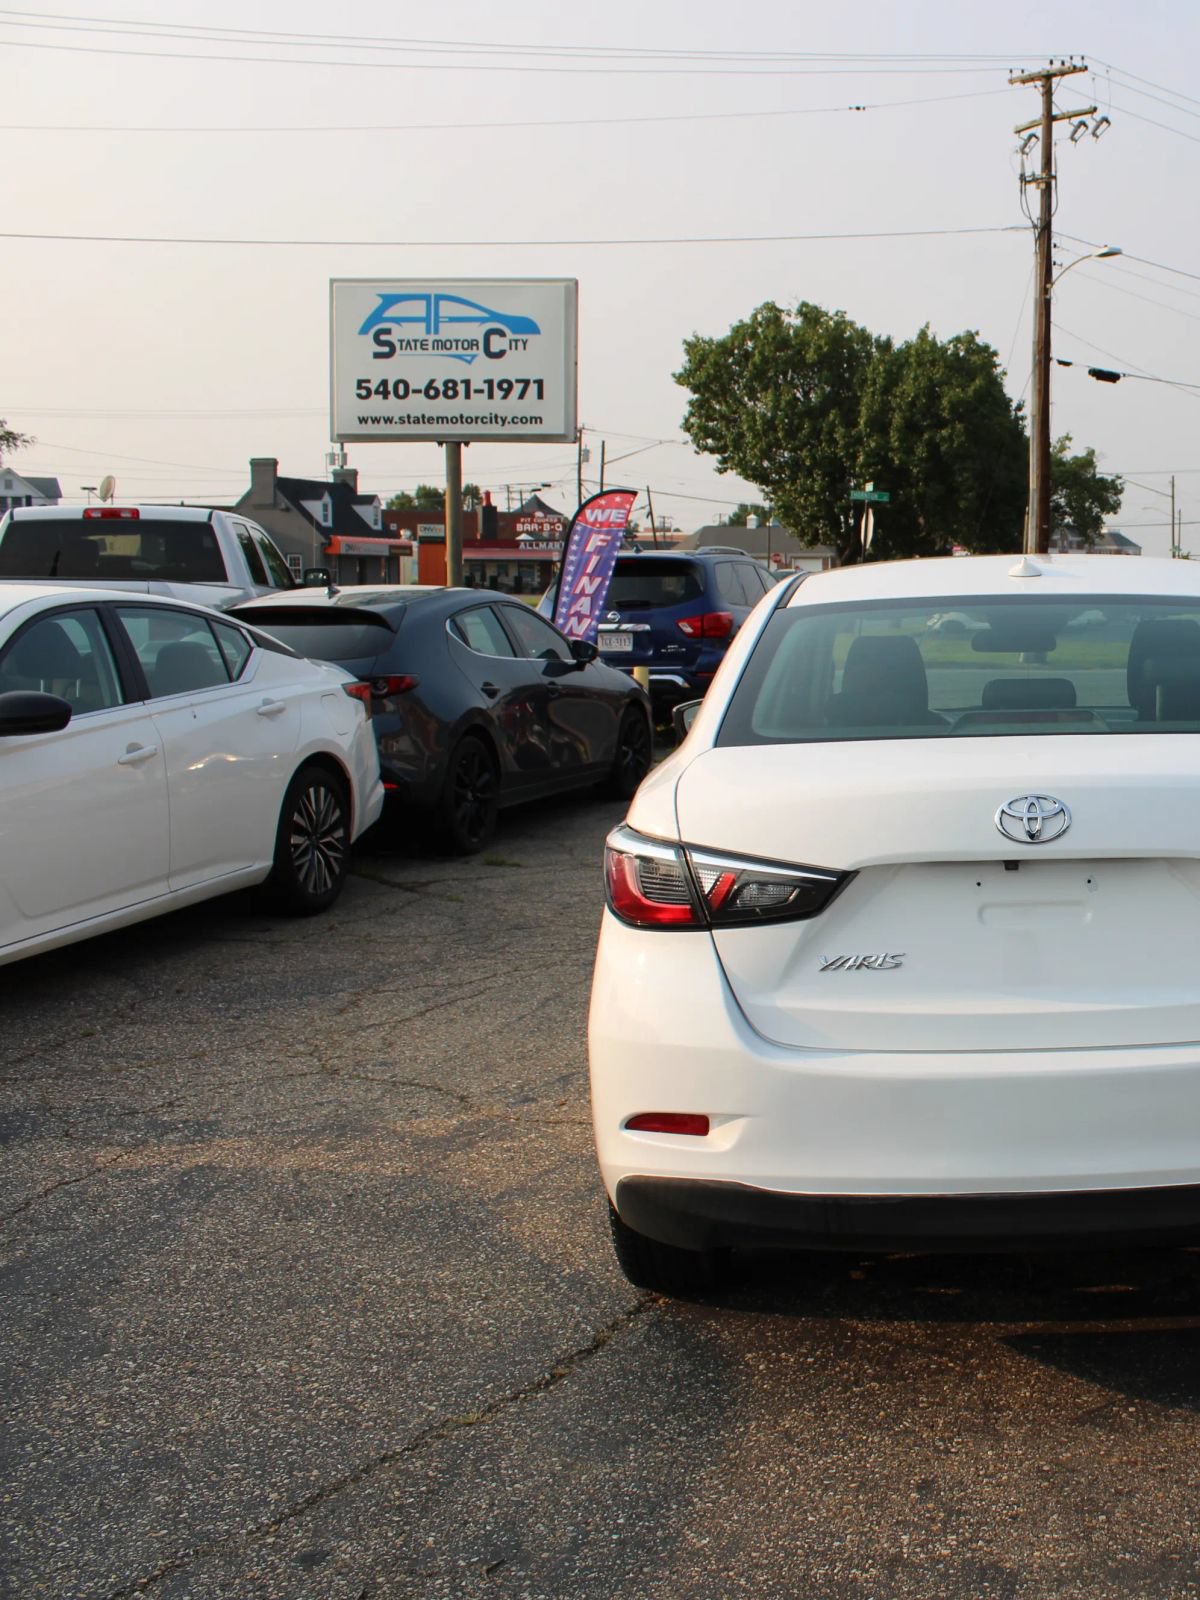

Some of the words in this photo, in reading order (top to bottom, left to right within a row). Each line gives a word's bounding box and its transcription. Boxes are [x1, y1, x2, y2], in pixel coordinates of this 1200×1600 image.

[372, 327, 429, 359] STATE
[432, 338, 479, 351] MOTOR
[483, 327, 529, 359] CITY
[355, 378, 544, 400] 540-681-1971
[357, 412, 543, 426] www.statemotorcity.com
[584, 508, 627, 522] WE
[564, 533, 611, 639] FINAN
[818, 953, 906, 972] YARIS
